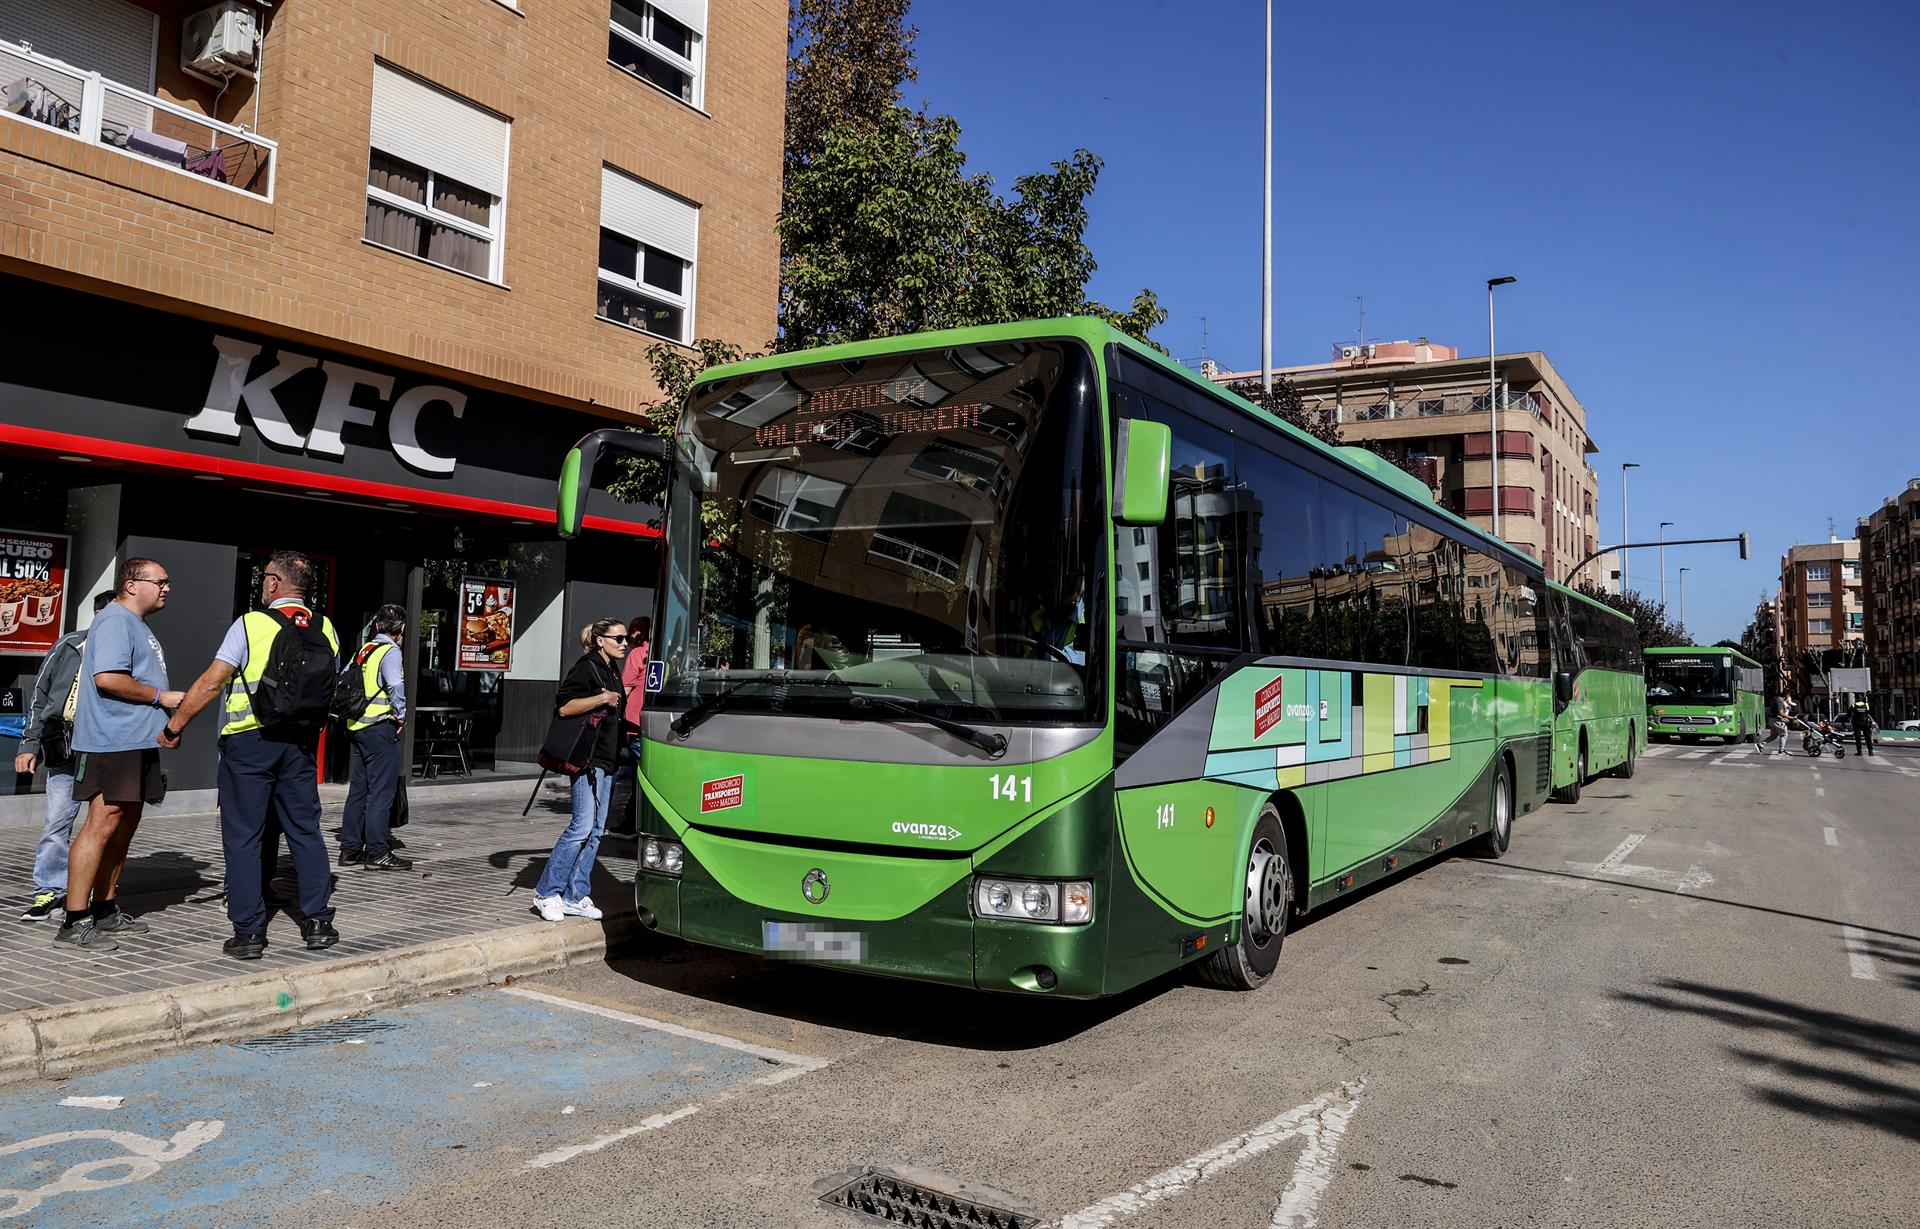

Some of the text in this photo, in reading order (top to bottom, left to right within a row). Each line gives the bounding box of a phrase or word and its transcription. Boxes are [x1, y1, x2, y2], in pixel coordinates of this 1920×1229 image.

[184, 335, 468, 476] KFC
[880, 403, 982, 435] TORRENT
[6, 538, 53, 548] SEGUNDO
[14, 559, 49, 581] 50%
[468, 593, 482, 613] 5€
[1256, 694, 1281, 720] TRANSPORTES
[1287, 704, 1310, 717] avanza
[704, 787, 740, 801] TRANSPORTES
[711, 777, 741, 791] CONSORCIO
[989, 773, 1031, 803] 141
[720, 796, 740, 807] MADRID
[1156, 803, 1174, 830] 141
[892, 821, 947, 837] avanza
